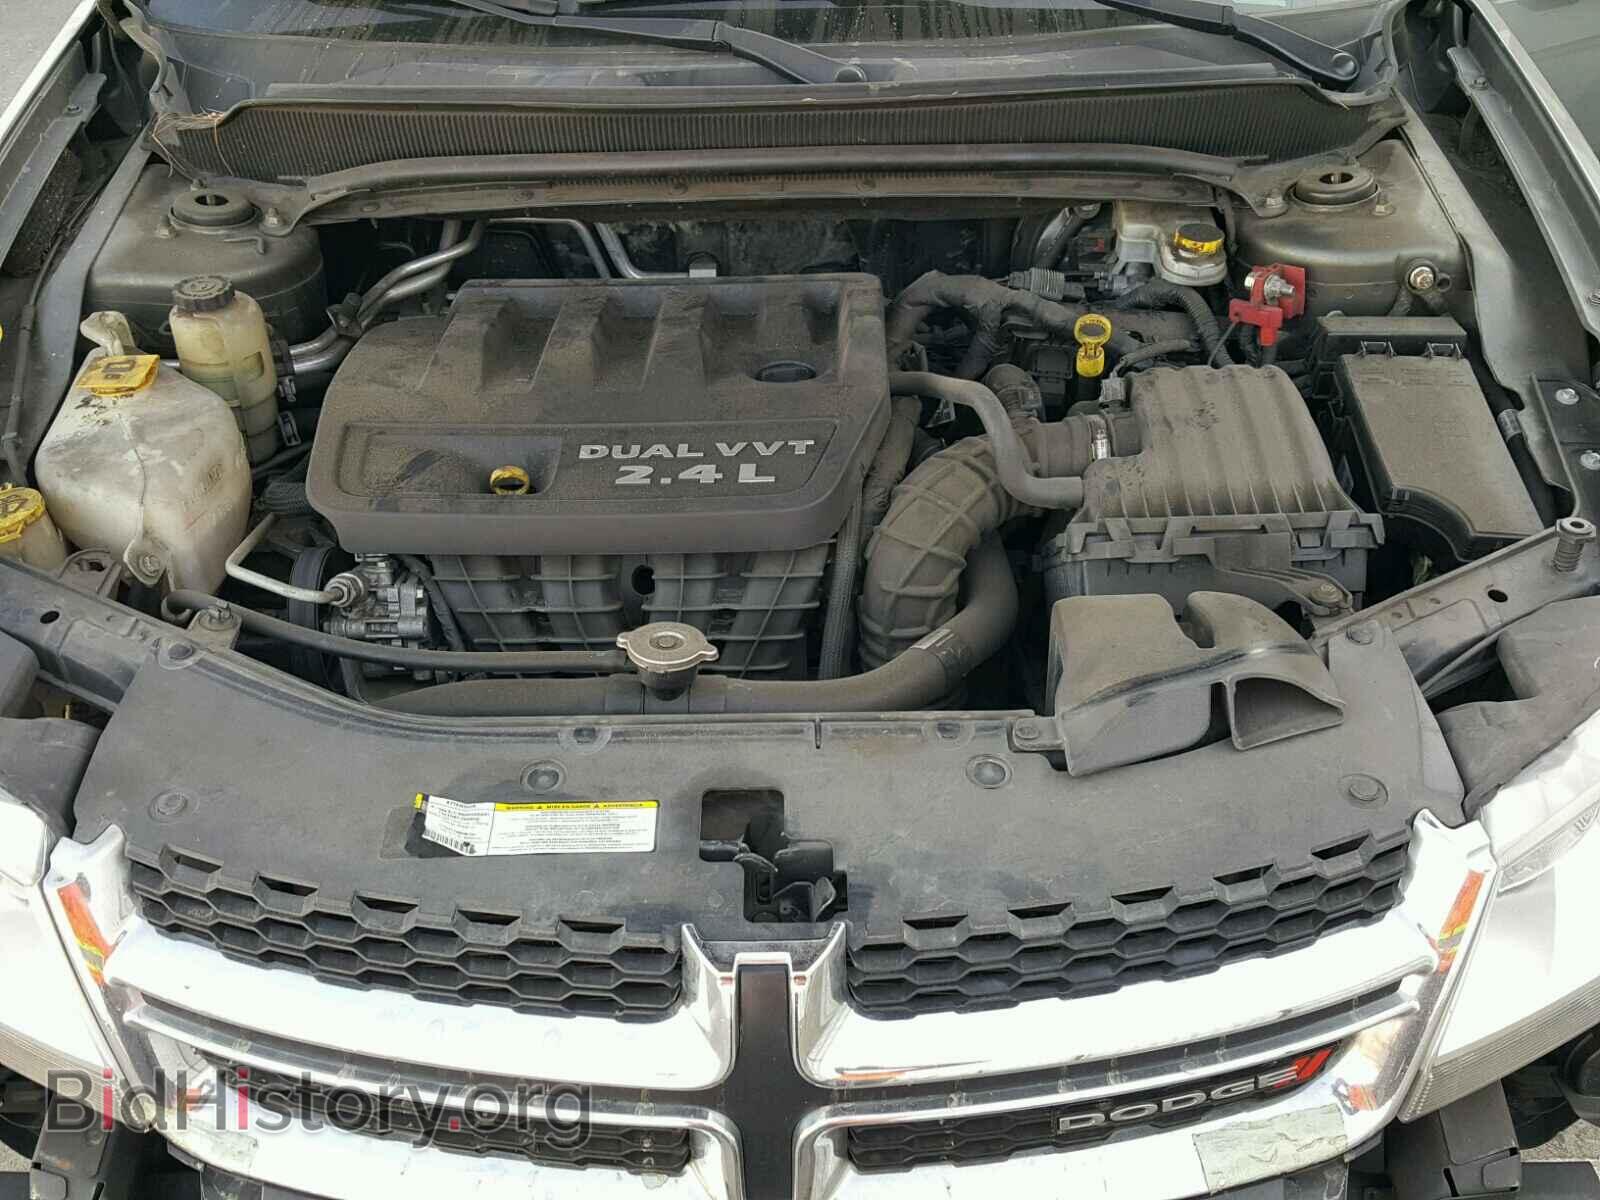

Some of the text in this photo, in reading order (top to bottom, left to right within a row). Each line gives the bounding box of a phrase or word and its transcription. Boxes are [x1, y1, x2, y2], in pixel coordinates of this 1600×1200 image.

[579, 440, 815, 459] DUAL VVT
[615, 464, 723, 484] 2.4
[1059, 1065, 1298, 1132] DODGE
